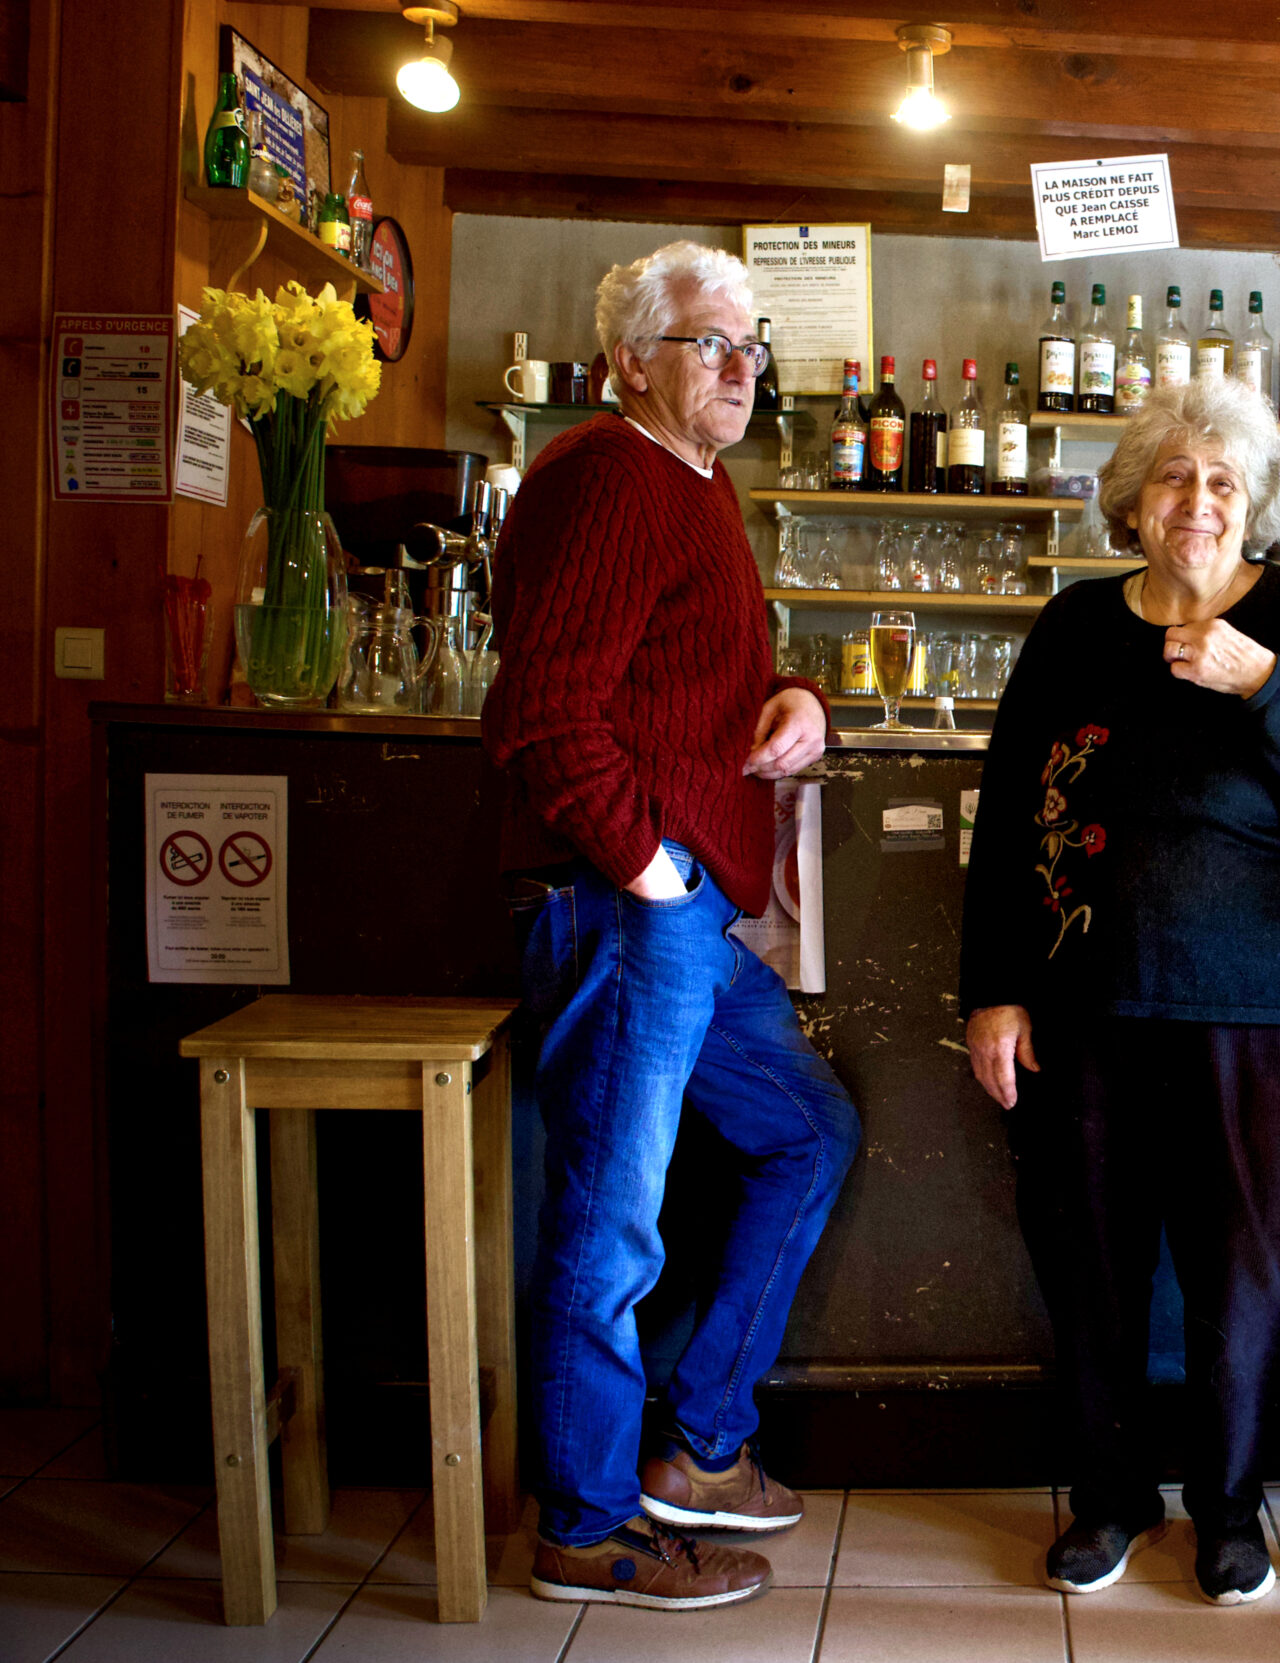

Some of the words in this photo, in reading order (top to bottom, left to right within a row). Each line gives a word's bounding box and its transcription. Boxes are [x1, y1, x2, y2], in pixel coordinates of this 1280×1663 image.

[1044, 180, 1059, 190] LA
[1062, 177, 1106, 189] MAISON
[1110, 175, 1125, 185] NE
[1128, 172, 1154, 183] FAIT
[1042, 192, 1071, 203] PLUS
[1073, 188, 1114, 201] CRÉDIT
[1118, 185, 1160, 196] DEPUIS
[1055, 204, 1078, 216] QUE
[1081, 203, 1107, 213] Jean
[1109, 198, 1150, 210] CAISSE
[1070, 217, 1077, 227] A
[1080, 210, 1139, 226] REMPLACÉ
[1073, 229, 1100, 240] Marc
[1103, 225, 1139, 237] LEMOI
[753, 241, 799, 251] PROTECTION
[803, 241, 818, 250] DES
[822, 240, 856, 249] MINEURS
[790, 257, 797, 265] DE
[800, 256, 826, 265] L'IVRESSE
[828, 256, 856, 265] PUBLIQUE
[60, 320, 102, 331] APPELS
[105, 320, 169, 332] D'URGENCE
[872, 420, 903, 429] PICON
[160, 802, 211, 810] INTERDICTION
[220, 803, 271, 811] INTERDICTION
[167, 811, 177, 819] DE
[178, 811, 205, 820] FUMER
[222, 812, 233, 820] DE
[234, 812, 268, 821] VAPOTER
